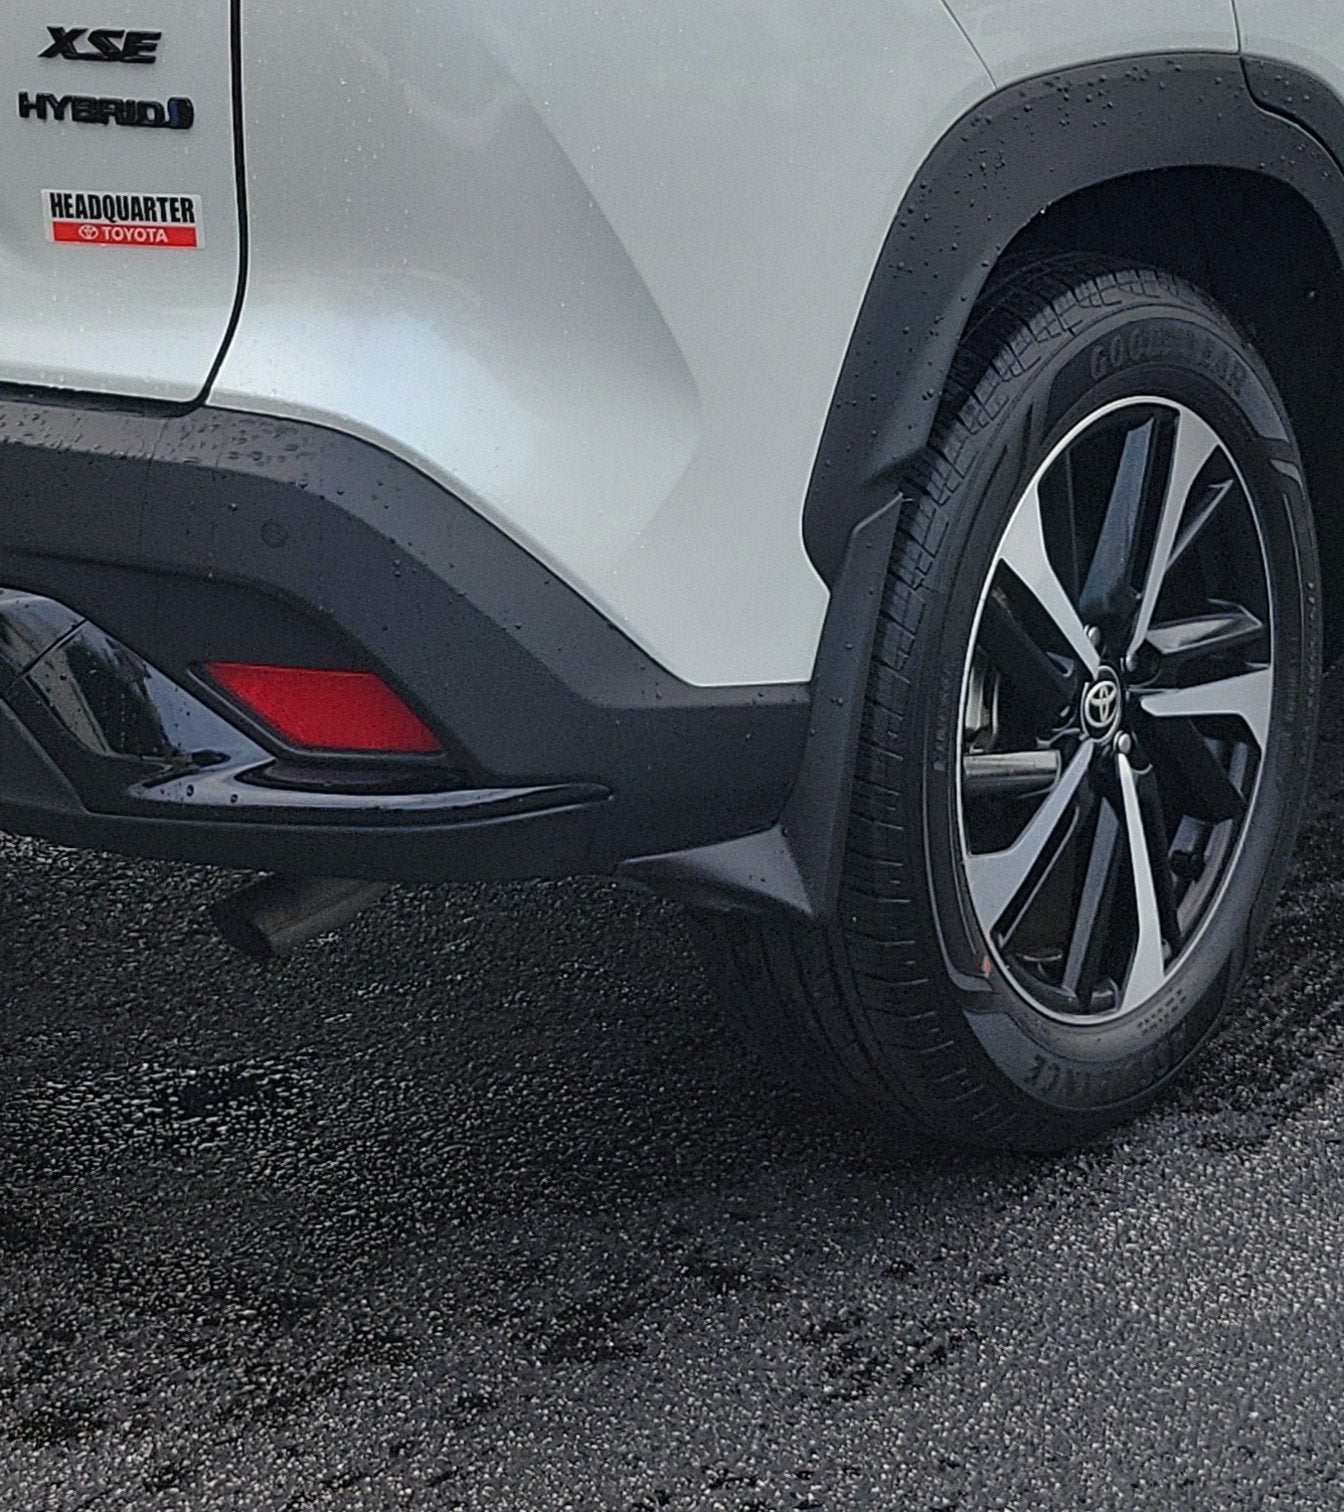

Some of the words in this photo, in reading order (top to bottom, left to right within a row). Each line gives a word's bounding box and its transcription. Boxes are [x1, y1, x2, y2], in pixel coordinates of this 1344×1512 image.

[38, 26, 162, 64] XSE
[18, 91, 165, 127] HYBRID
[49, 192, 195, 224] HEADQUARTER
[102, 226, 169, 243] TOYOTA
